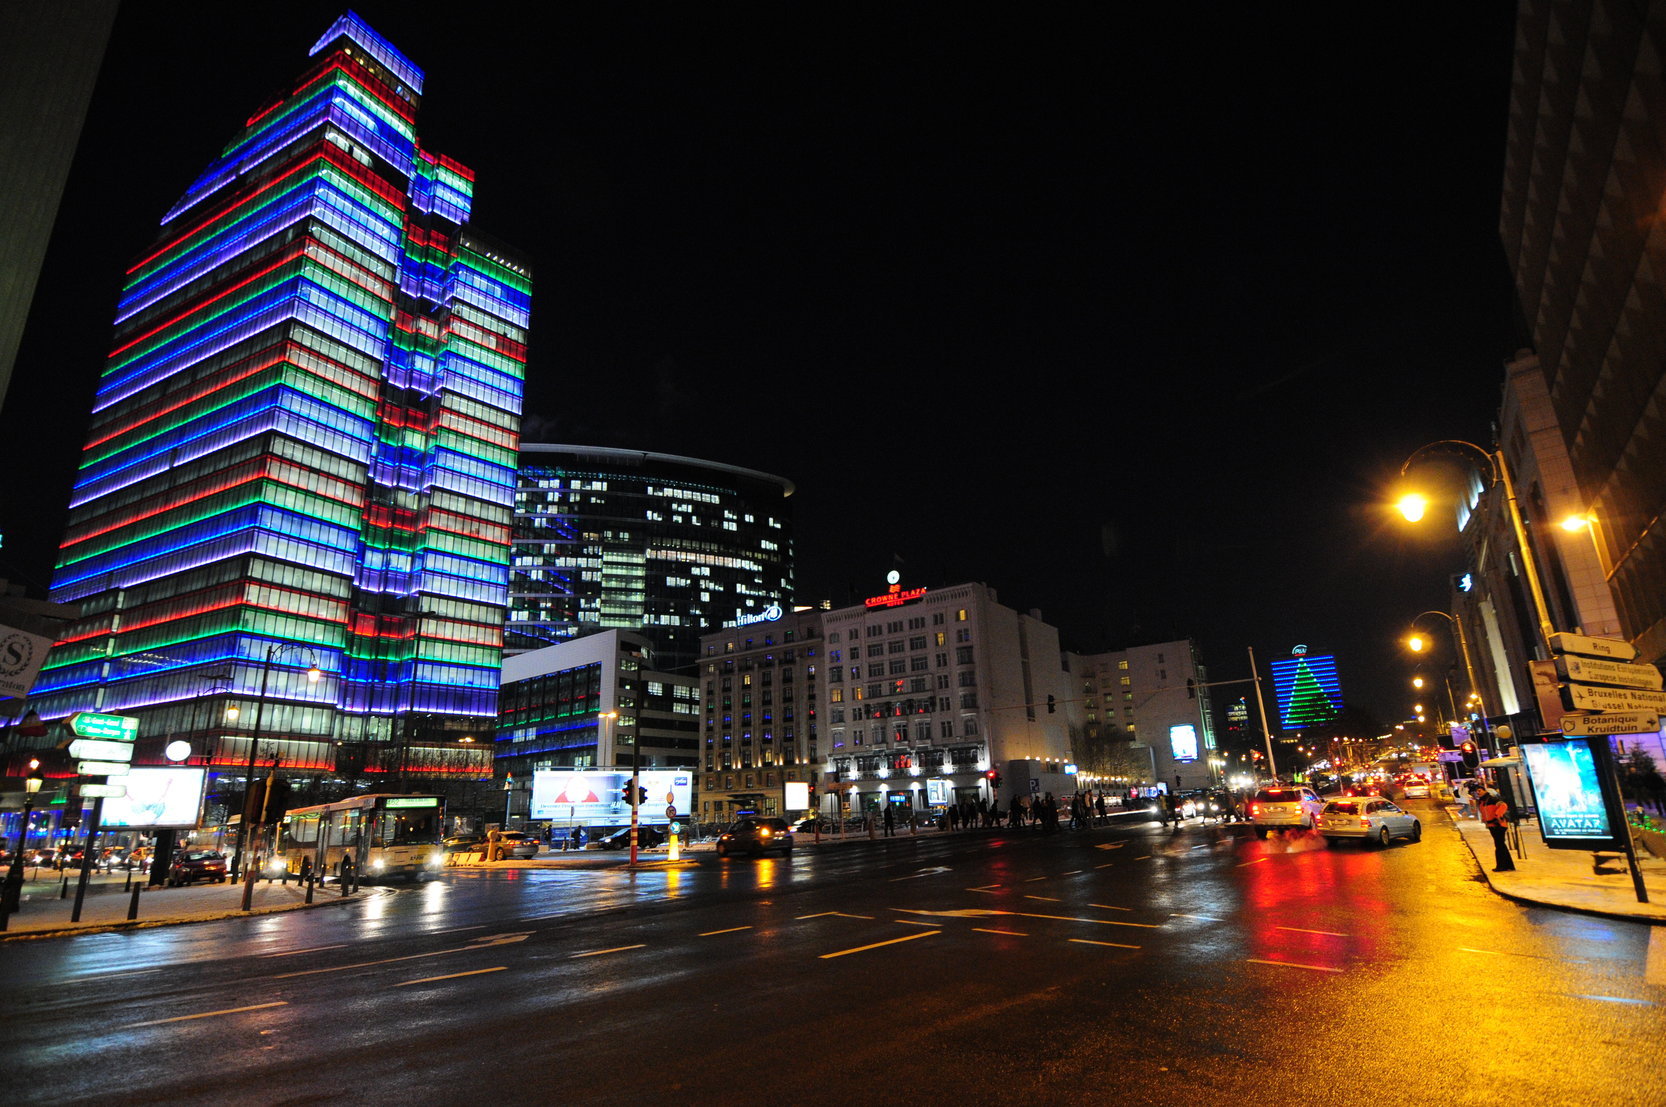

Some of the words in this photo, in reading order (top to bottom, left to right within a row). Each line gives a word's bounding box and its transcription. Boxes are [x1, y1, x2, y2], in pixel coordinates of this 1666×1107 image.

[865, 593, 899, 605] CROWNE
[901, 587, 926, 598] PLAZA
[737, 612, 766, 626] Hilton
[1592, 642, 1611, 654] Ring
[1587, 688, 1628, 700] Bruxelles
[1630, 691, 1665, 703] National
[1591, 700, 1625, 710] Bussel
[1583, 715, 1638, 725] Botanique
[1587, 724, 1638, 734] Kruidtuin
[1551, 819, 1603, 829] AVATAR
